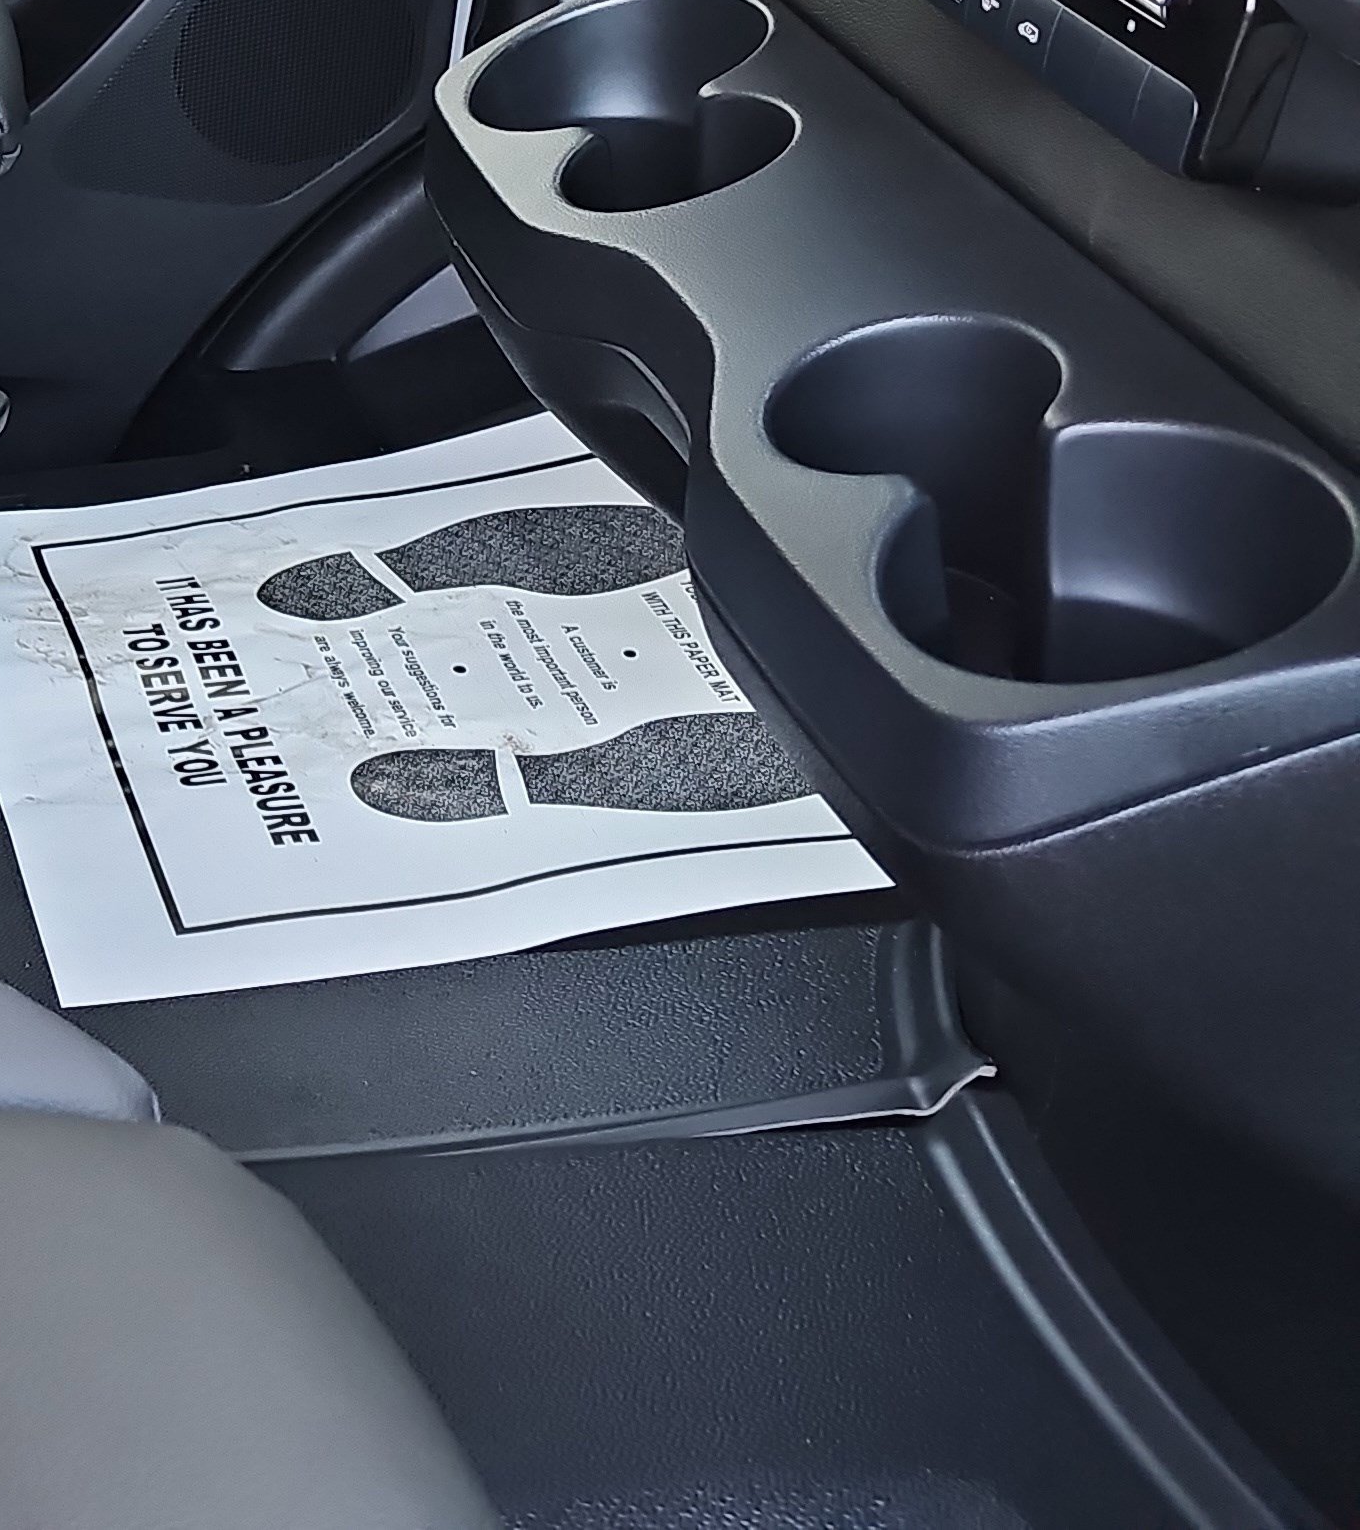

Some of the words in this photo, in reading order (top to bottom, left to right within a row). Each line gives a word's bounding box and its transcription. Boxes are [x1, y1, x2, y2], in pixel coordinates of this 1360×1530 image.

[155, 576, 201, 591] IT
[166, 593, 221, 632] HAS
[479, 619, 497, 630] in
[561, 625, 579, 634] A
[122, 623, 171, 652] TO
[487, 632, 506, 649] the
[569, 635, 610, 680] customer
[641, 591, 674, 616] WITH
[662, 617, 692, 640] THIS
[679, 641, 720, 679] PAPER
[708, 680, 741, 703] MAT
[187, 639, 251, 699] BEEN
[349, 628, 384, 677] improving
[378, 679, 396, 698] our
[388, 699, 418, 738] service
[388, 626, 409, 648] Your
[402, 650, 446, 711] suggestions
[438, 714, 457, 729] for
[499, 653, 530, 682] world
[505, 600, 525, 617] the
[516, 619, 545, 644] most
[533, 644, 577, 690] important
[560, 691, 599, 726] person
[135, 656, 204, 733] SERVE
[314, 635, 331, 653] are
[324, 655, 350, 688] always
[343, 690, 376, 739] welcome.
[517, 683, 534, 694] to
[601, 680, 619, 691] is
[213, 706, 259, 721] A
[167, 738, 227, 786] YOU
[223, 726, 321, 846] PLEASURE
